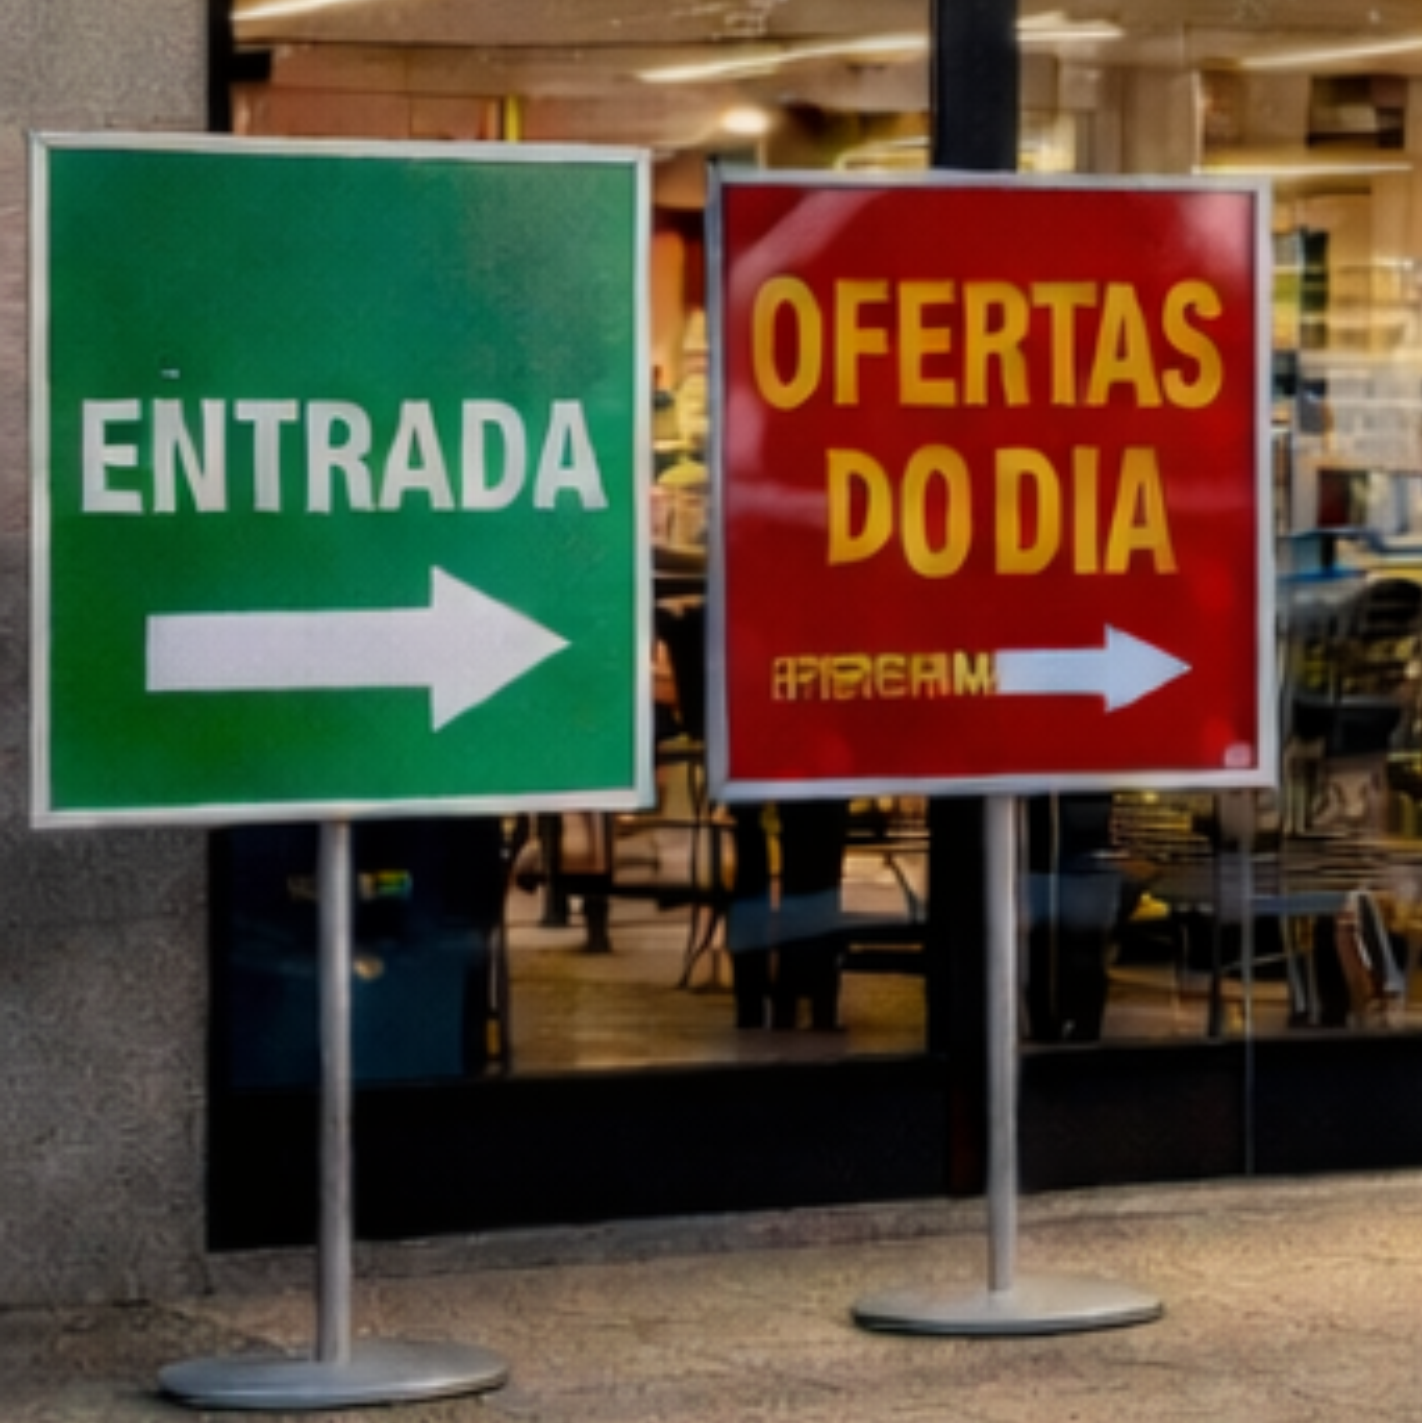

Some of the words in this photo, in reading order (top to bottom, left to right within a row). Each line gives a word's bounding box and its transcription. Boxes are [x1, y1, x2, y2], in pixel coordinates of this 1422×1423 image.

[751, 275, 1225, 412] OFERTAS
[79, 397, 610, 516] ENTRADA
[825, 444, 974, 578] DO
[993, 444, 1180, 577] DIA
